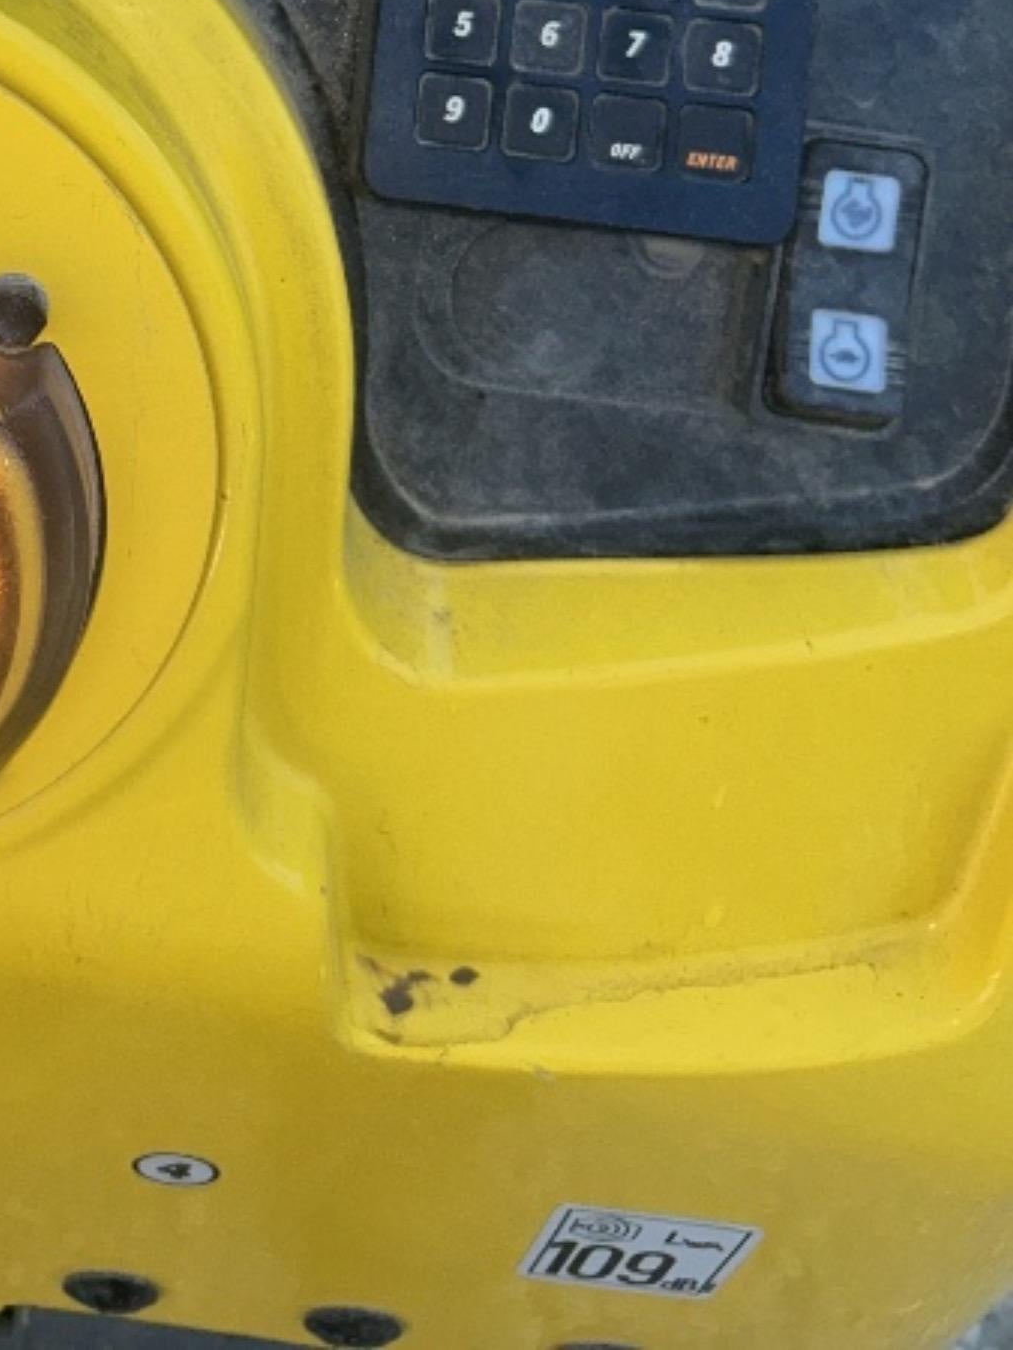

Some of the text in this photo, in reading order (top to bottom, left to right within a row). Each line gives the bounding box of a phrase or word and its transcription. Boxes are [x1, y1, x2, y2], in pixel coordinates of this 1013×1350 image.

[454, 11, 734, 68] 5 6 7 8
[443, 95, 739, 172] 9 0 OFF ENTER
[545, 1240, 676, 1286] 109
